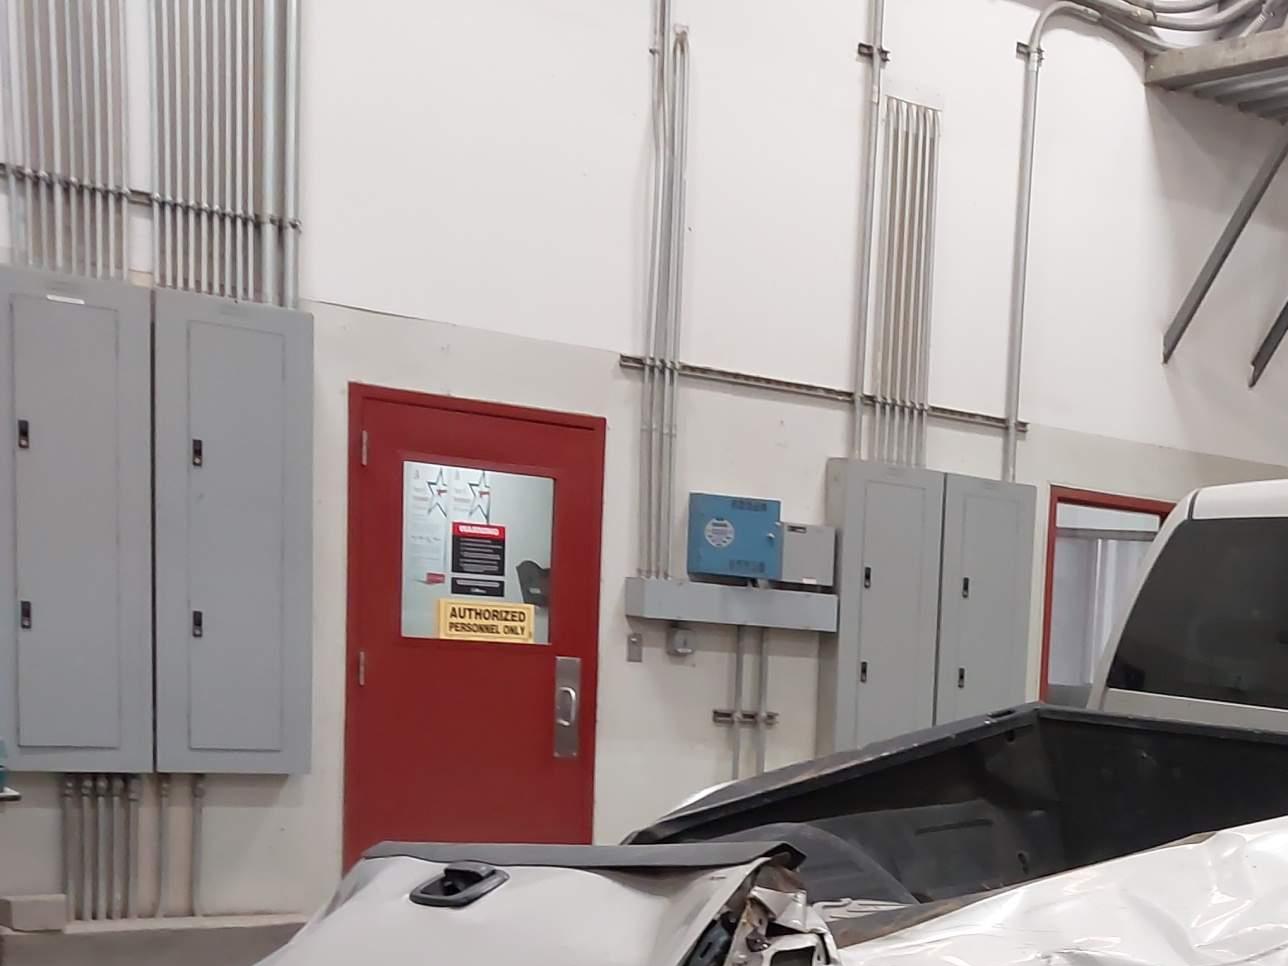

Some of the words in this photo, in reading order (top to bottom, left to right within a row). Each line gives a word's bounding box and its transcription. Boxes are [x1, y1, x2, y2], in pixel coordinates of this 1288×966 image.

[449, 606, 526, 622] AUTHORIZED
[448, 622, 501, 634] PERSONNEL
[503, 625, 526, 635] ONLY
